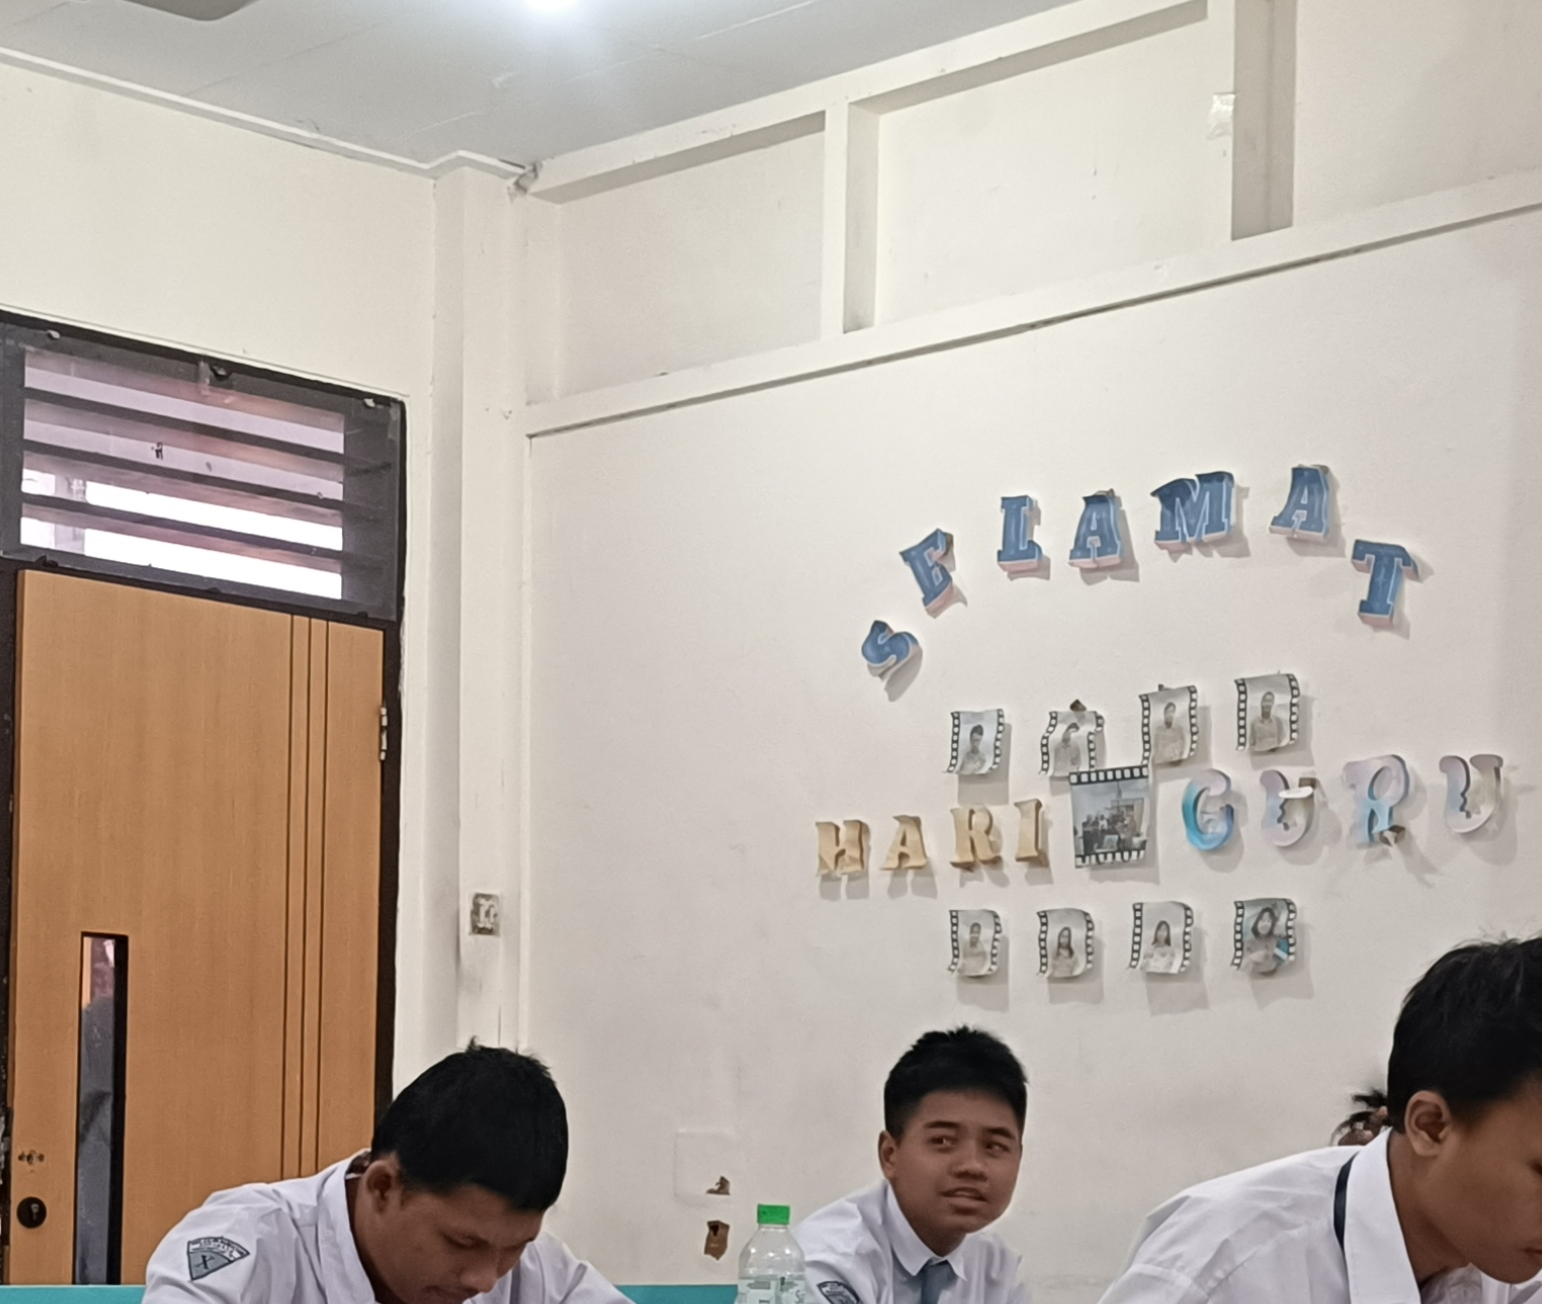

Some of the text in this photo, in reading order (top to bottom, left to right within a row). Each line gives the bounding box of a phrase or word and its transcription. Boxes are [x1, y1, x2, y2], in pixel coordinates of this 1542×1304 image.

[861, 464, 1416, 672] SELAMAT
[815, 753, 1505, 878] HARI GURU
